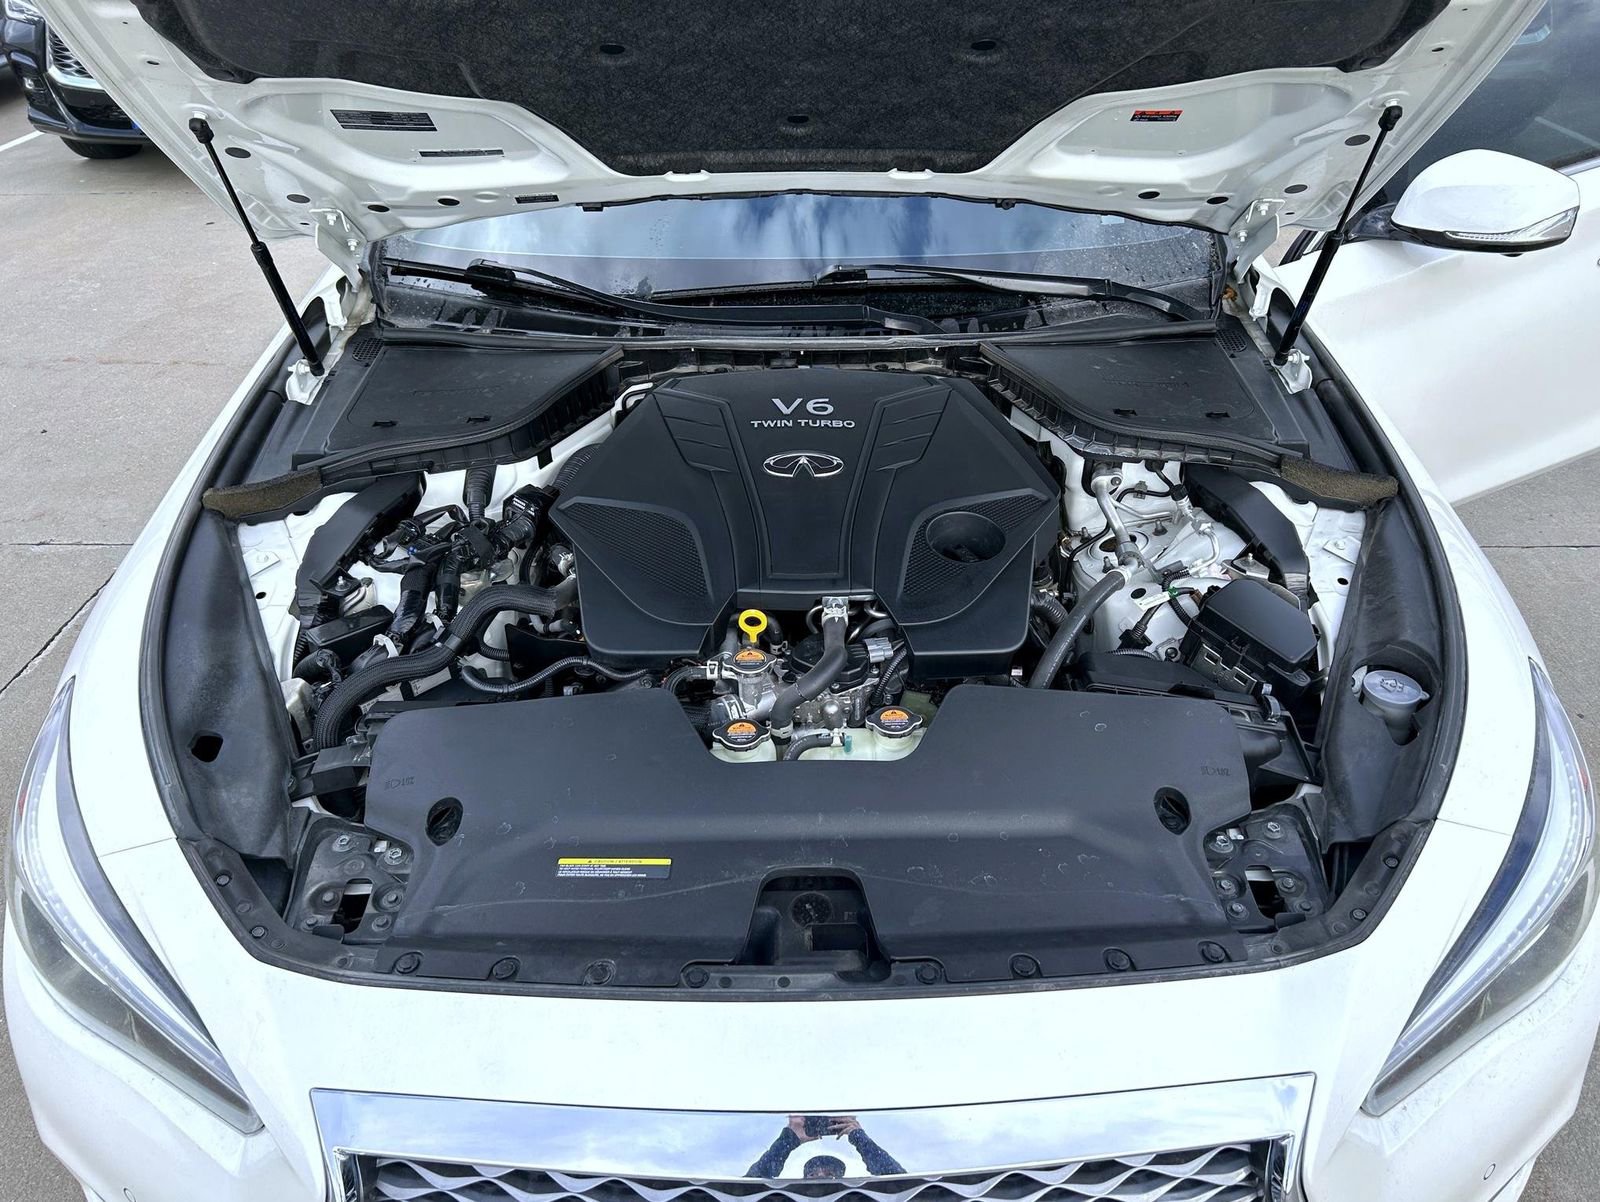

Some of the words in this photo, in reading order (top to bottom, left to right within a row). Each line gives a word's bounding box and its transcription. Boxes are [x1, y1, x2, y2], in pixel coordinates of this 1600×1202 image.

[771, 398, 834, 416] V6
[750, 419, 793, 428] TWIN
[797, 419, 856, 428] TURBO
